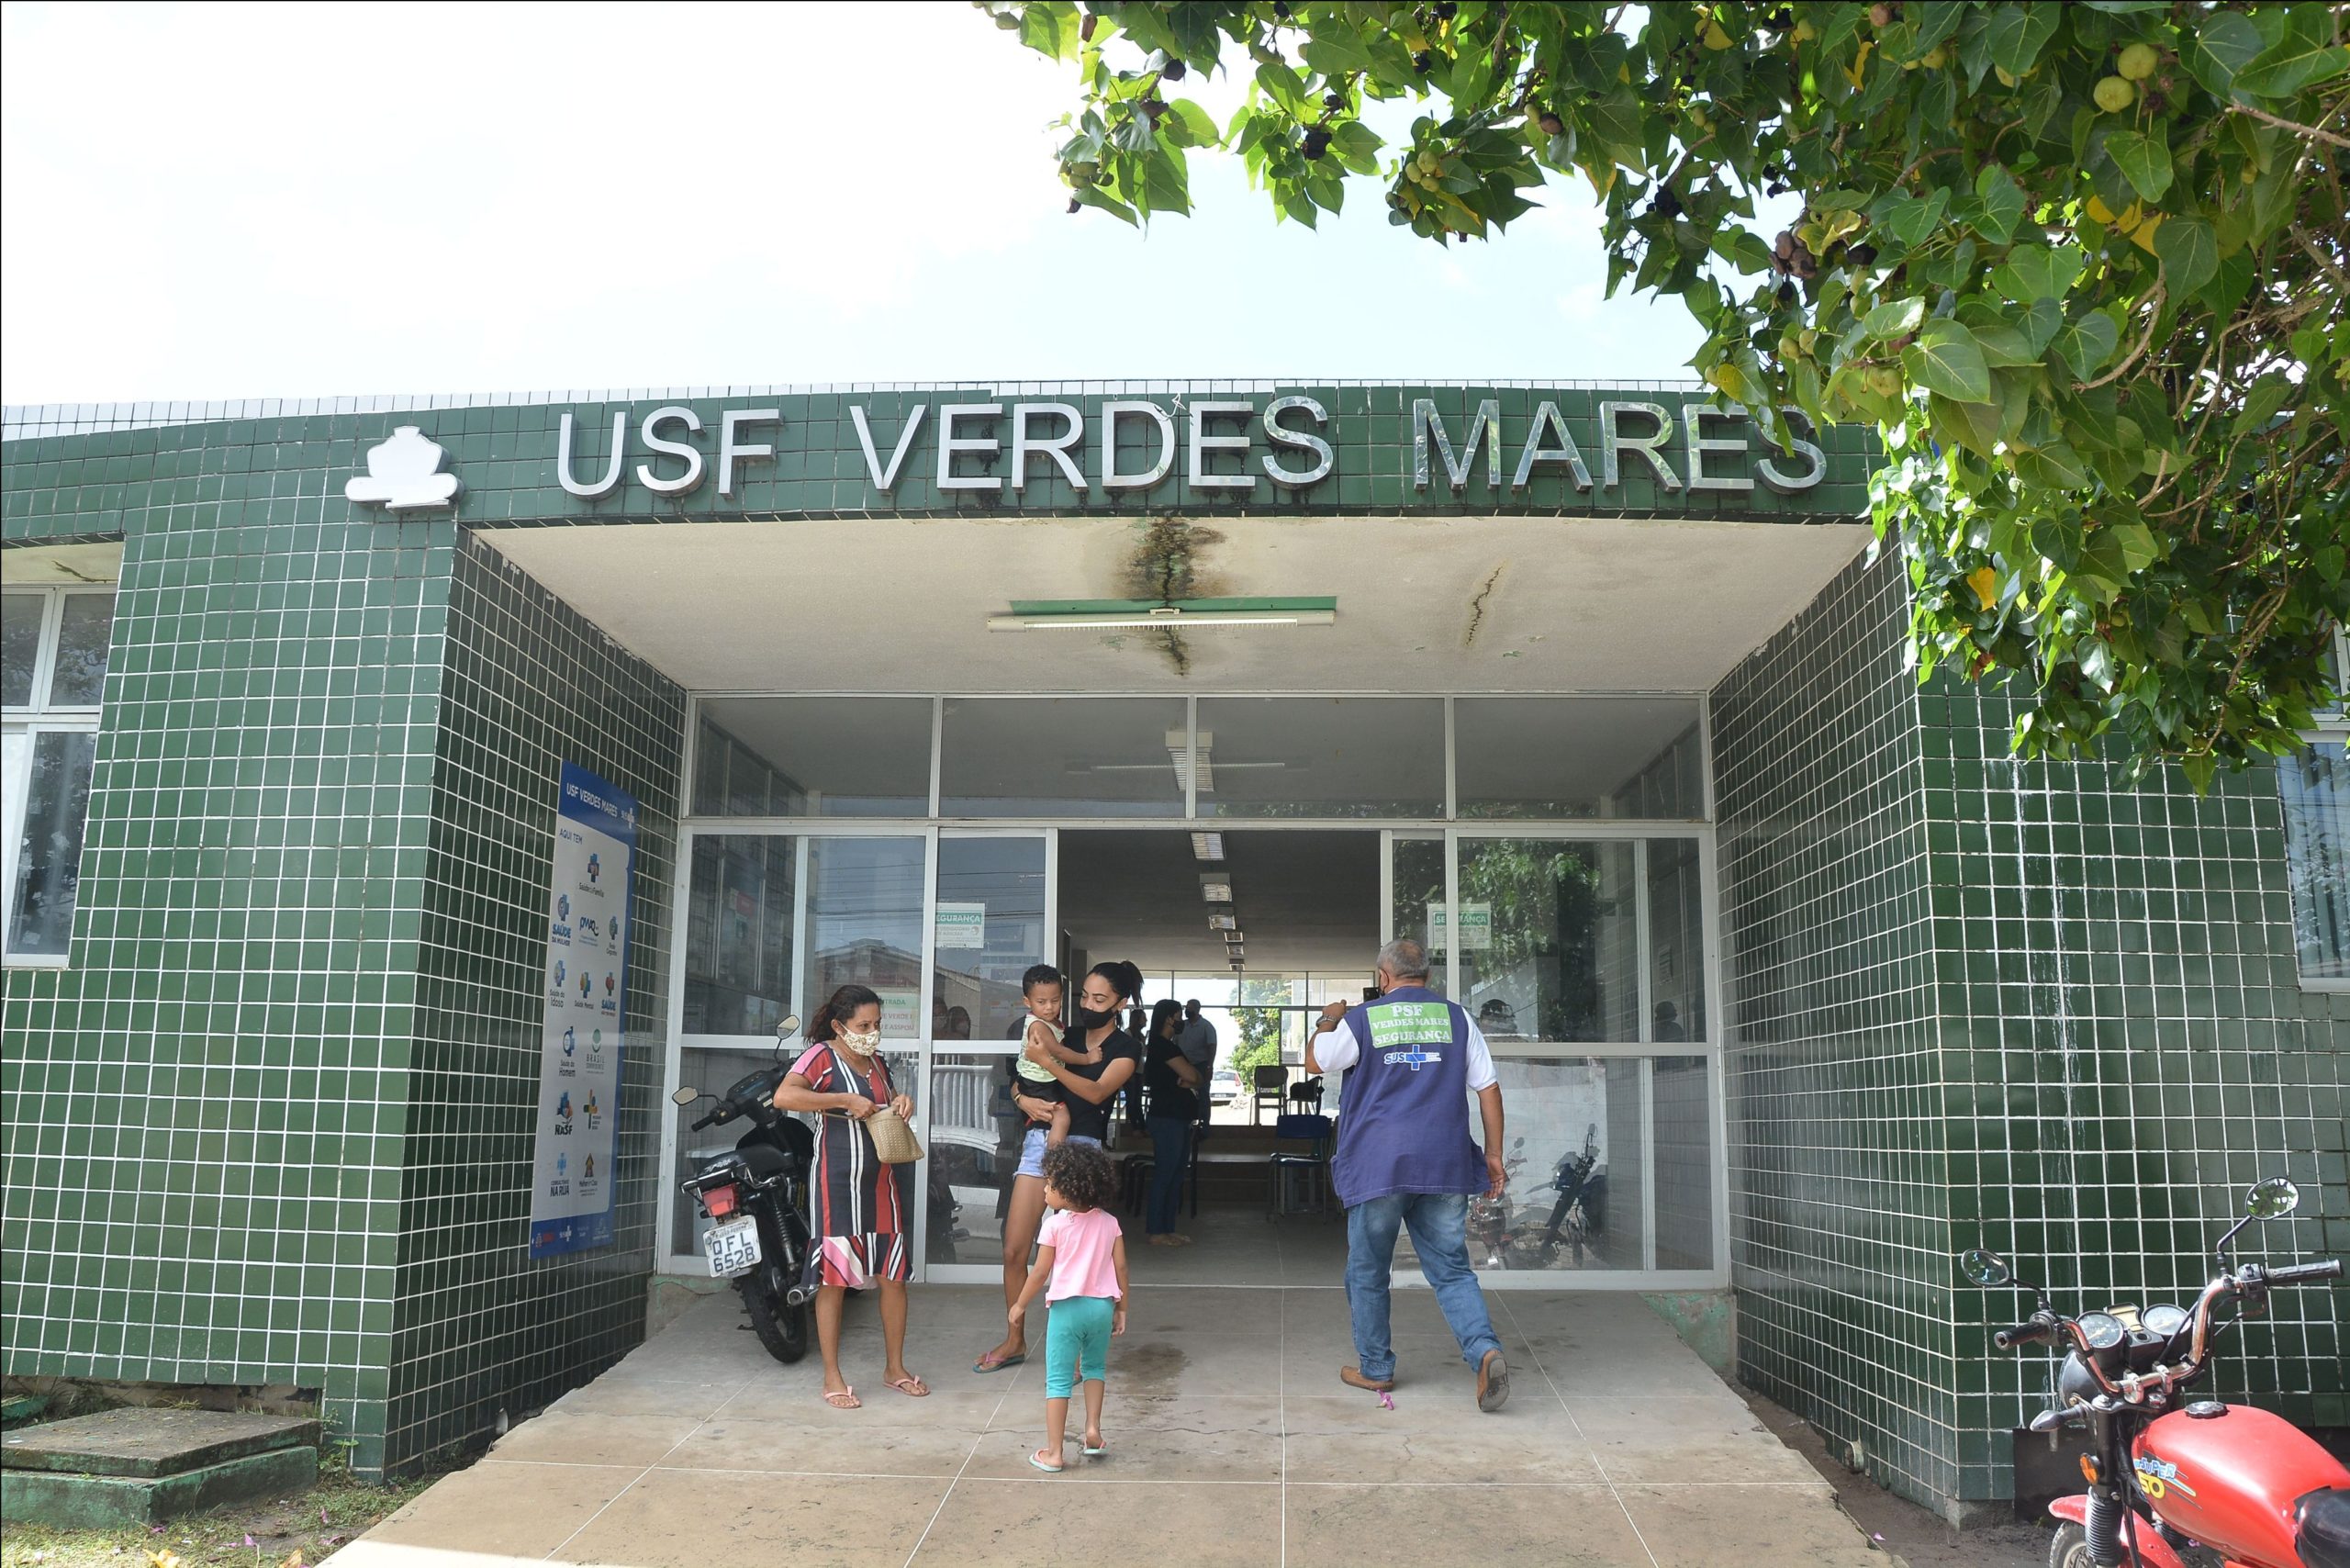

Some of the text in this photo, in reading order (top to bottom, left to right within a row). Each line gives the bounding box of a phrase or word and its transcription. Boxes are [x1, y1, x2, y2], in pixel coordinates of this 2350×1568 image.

[557, 395, 1828, 501] USF VERDES MARES
[566, 782, 579, 798] USF
[579, 789, 601, 809] VERDES
[601, 799, 618, 818] MARES
[559, 828, 583, 845] AQUI TEM
[935, 913, 981, 924] EGURANÇA
[1436, 913, 1487, 924] SEANÇA
[553, 924, 571, 938] SAÚDE
[1391, 1004, 1424, 1017] PSF
[1371, 1017, 1449, 1029] VERDES MARES
[1373, 1030, 1450, 1044] SEGURANÇA
[1384, 1052, 1404, 1064] SUS
[554, 1124, 573, 1135] NASF
[550, 1186, 558, 1197] NA
[558, 1185, 569, 1196] RUA
[711, 1232, 751, 1255] QFL
[713, 1246, 755, 1273] 6528
[2140, 1457, 2177, 1479] SUPER
